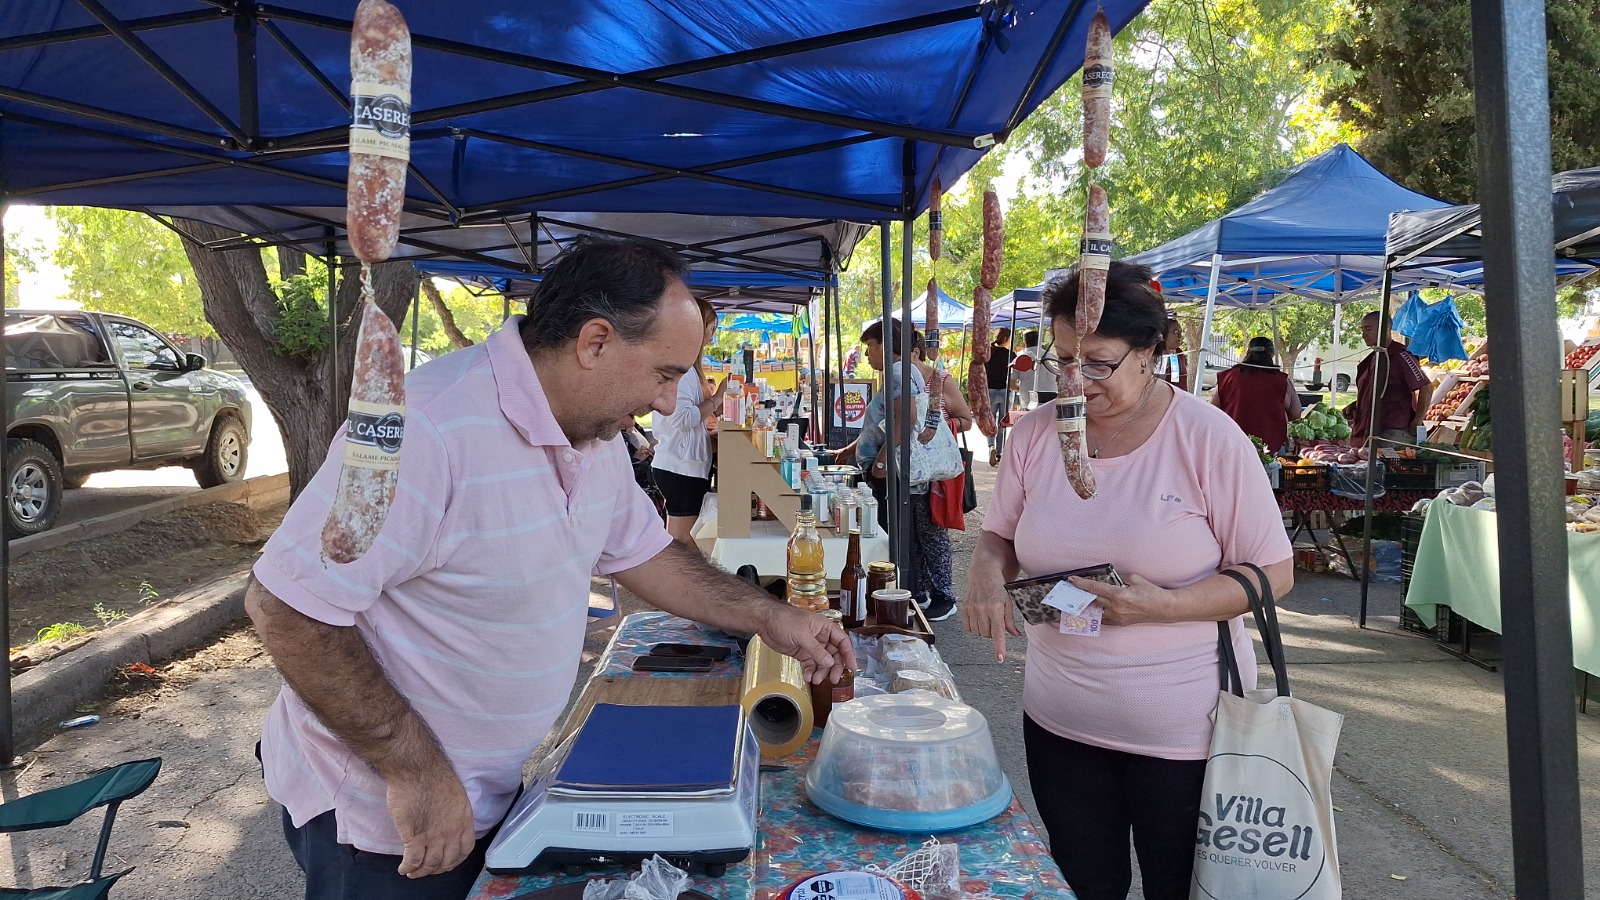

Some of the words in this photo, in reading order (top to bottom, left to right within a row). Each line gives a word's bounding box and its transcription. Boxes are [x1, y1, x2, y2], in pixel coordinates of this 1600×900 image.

[1090, 619, 1098, 632] 100
[1215, 793, 1286, 828] Villa
[1209, 854, 1252, 868] QUERER
[1253, 859, 1297, 873] VOLVER
